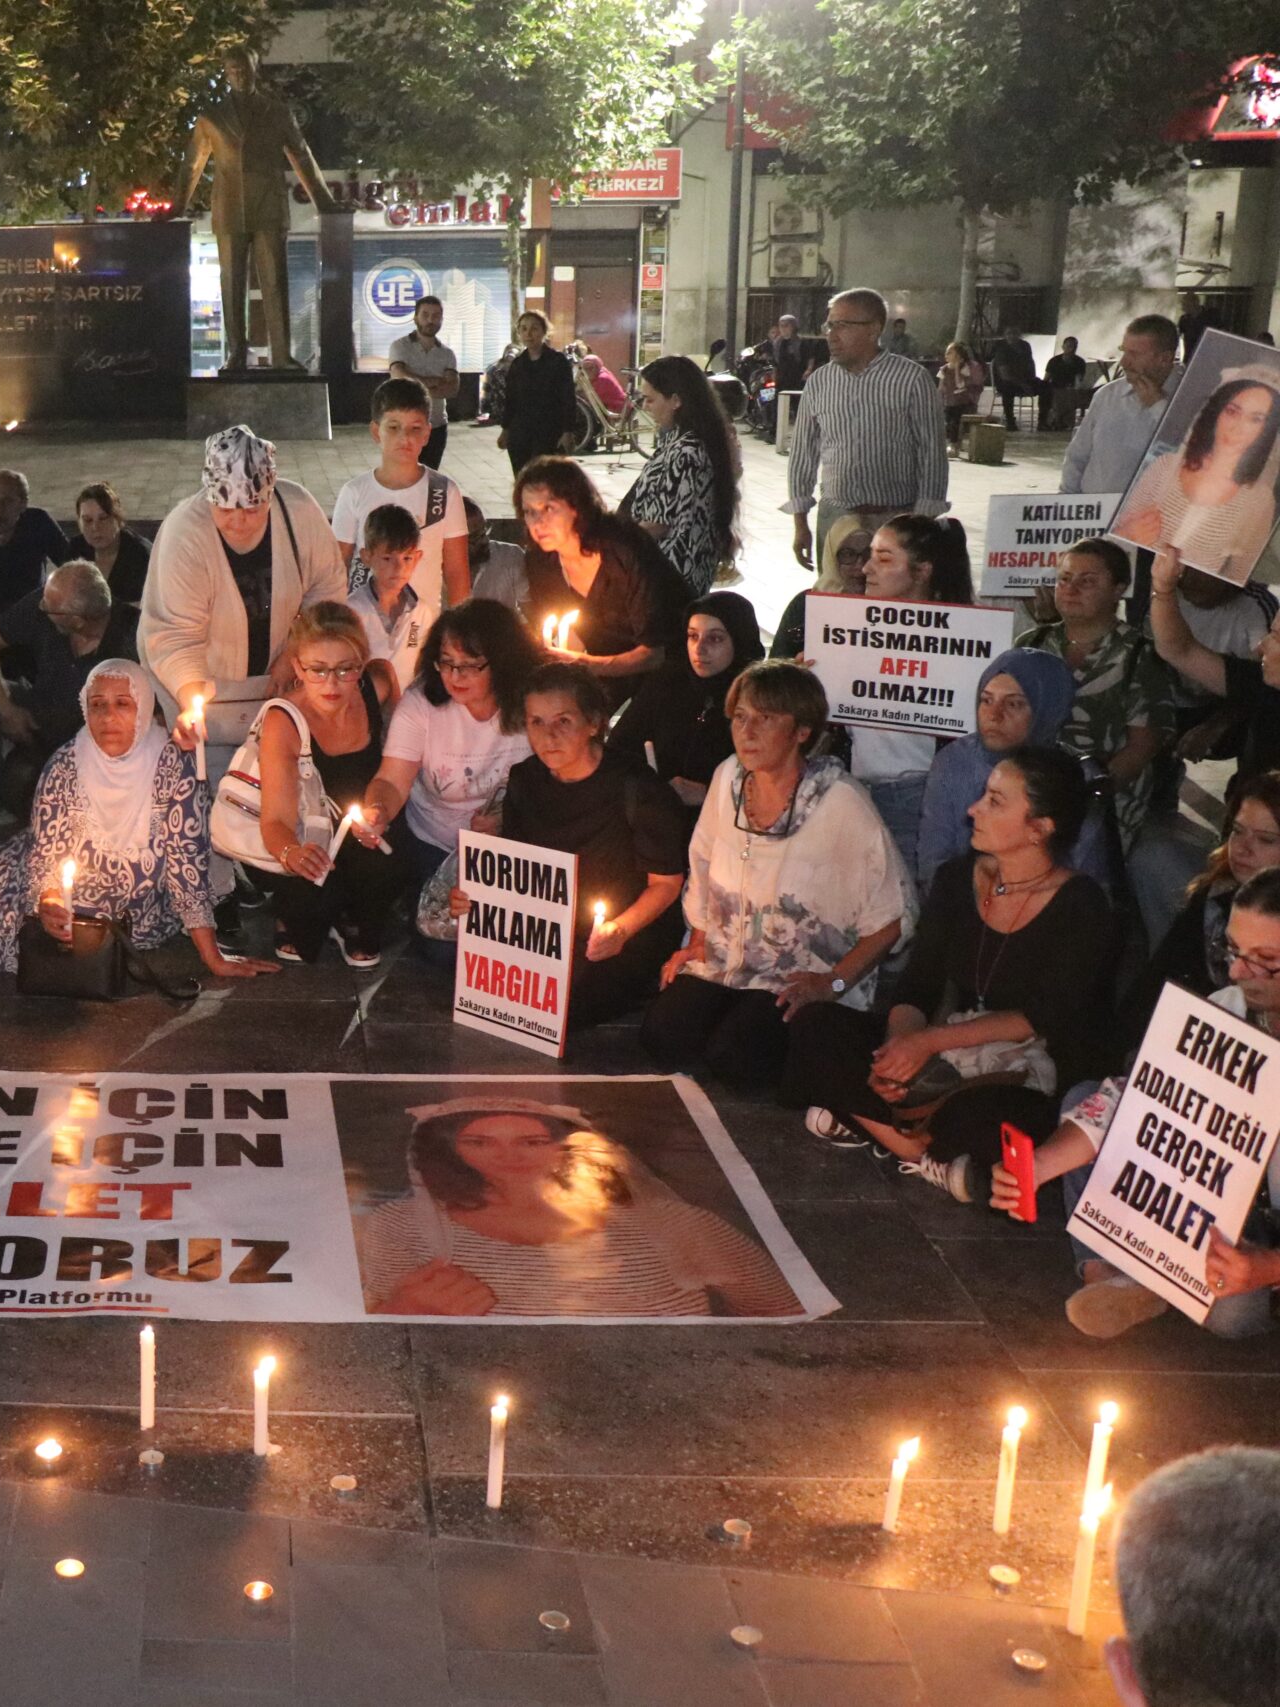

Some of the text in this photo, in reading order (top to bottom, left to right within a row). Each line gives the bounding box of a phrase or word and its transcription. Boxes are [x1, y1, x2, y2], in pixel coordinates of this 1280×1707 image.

[431, 488, 444, 516] NYC
[1022, 501, 1102, 522] KATİLLERİ
[988, 551, 1064, 568] HESAPLA
[1041, 575, 1057, 585] Kad
[865, 605, 950, 629] ÇOCUK
[822, 624, 993, 659] İSTİSMARININ
[879, 657, 928, 678] AFFI
[837, 703, 965, 728] Sakarya Kadın Platformu
[851, 679, 955, 708] OLMAZ!!!
[464, 845, 569, 906] KORUMA
[466, 899, 562, 960] AKLAMA
[463, 950, 558, 1016] YARGILA
[458, 996, 558, 1039] Sakarya Kadın Platformu
[1175, 1013, 1269, 1095] ERKEK
[68, 1081, 290, 1126] İÇİN
[1132, 1060, 1268, 1165] ADALET DEĞİL
[51, 1126, 284, 1175] İÇİN
[1135, 1111, 1234, 1199] GERÇEK
[1110, 1159, 1217, 1252] ADALET
[1080, 1200, 1211, 1298] Sakarya Kadın Platformu
